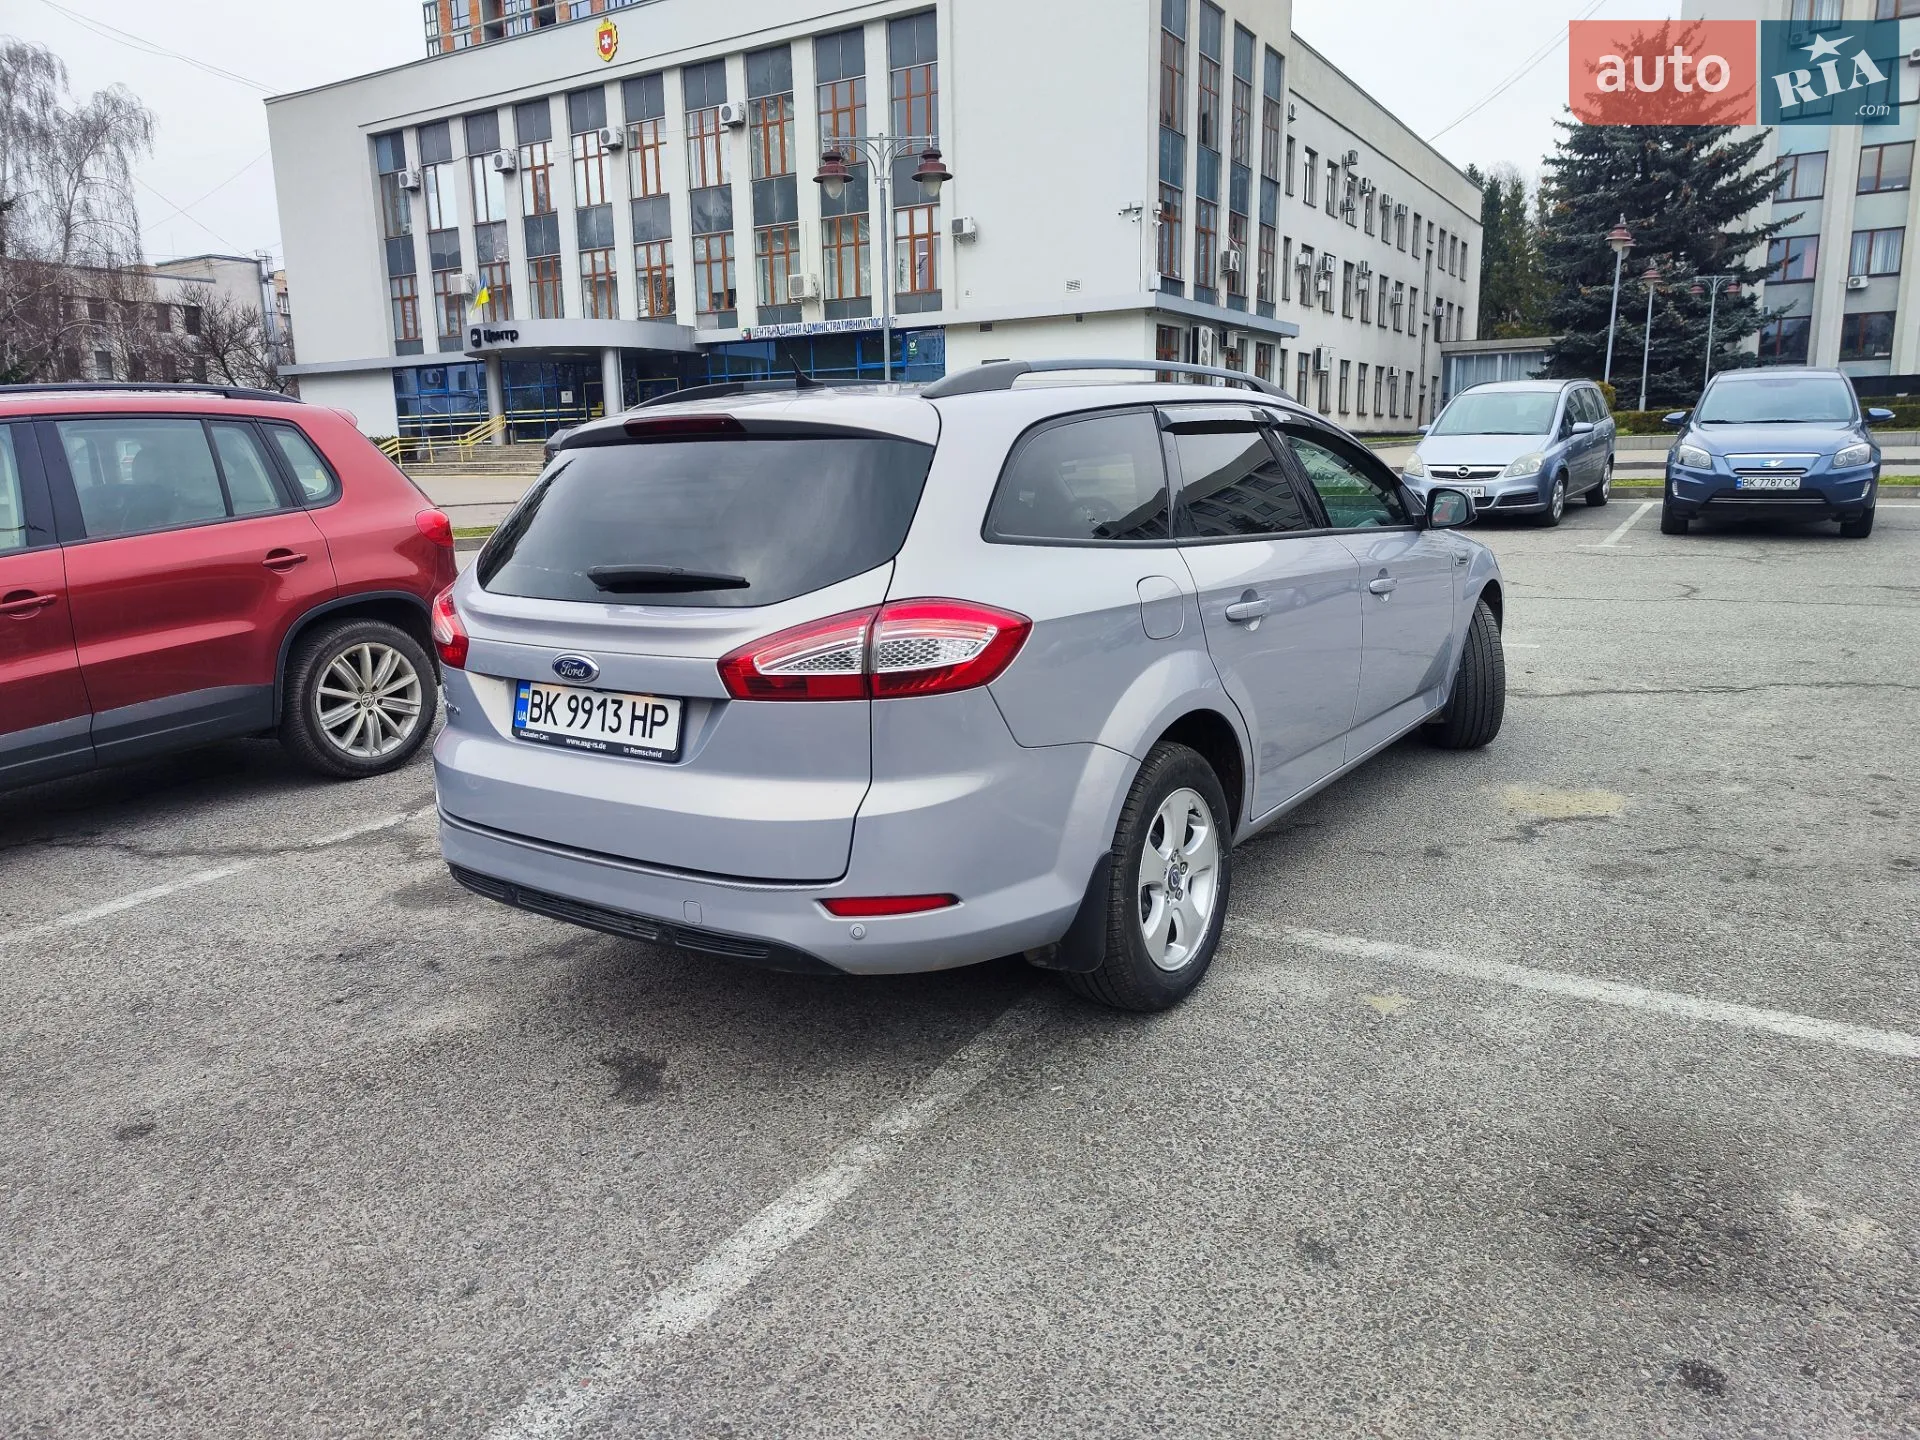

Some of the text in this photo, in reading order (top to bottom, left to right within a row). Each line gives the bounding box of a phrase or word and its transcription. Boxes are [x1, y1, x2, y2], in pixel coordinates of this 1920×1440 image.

[483, 329, 519, 343] Центр
[751, 326, 770, 338] ЦЕНТР
[1742, 479, 1756, 487] BK
[1759, 479, 1782, 487] 7787
[1784, 479, 1798, 487] CK
[559, 660, 586, 678] Ford
[517, 710, 527, 721] UA
[529, 690, 669, 739] BK 9913 HP
